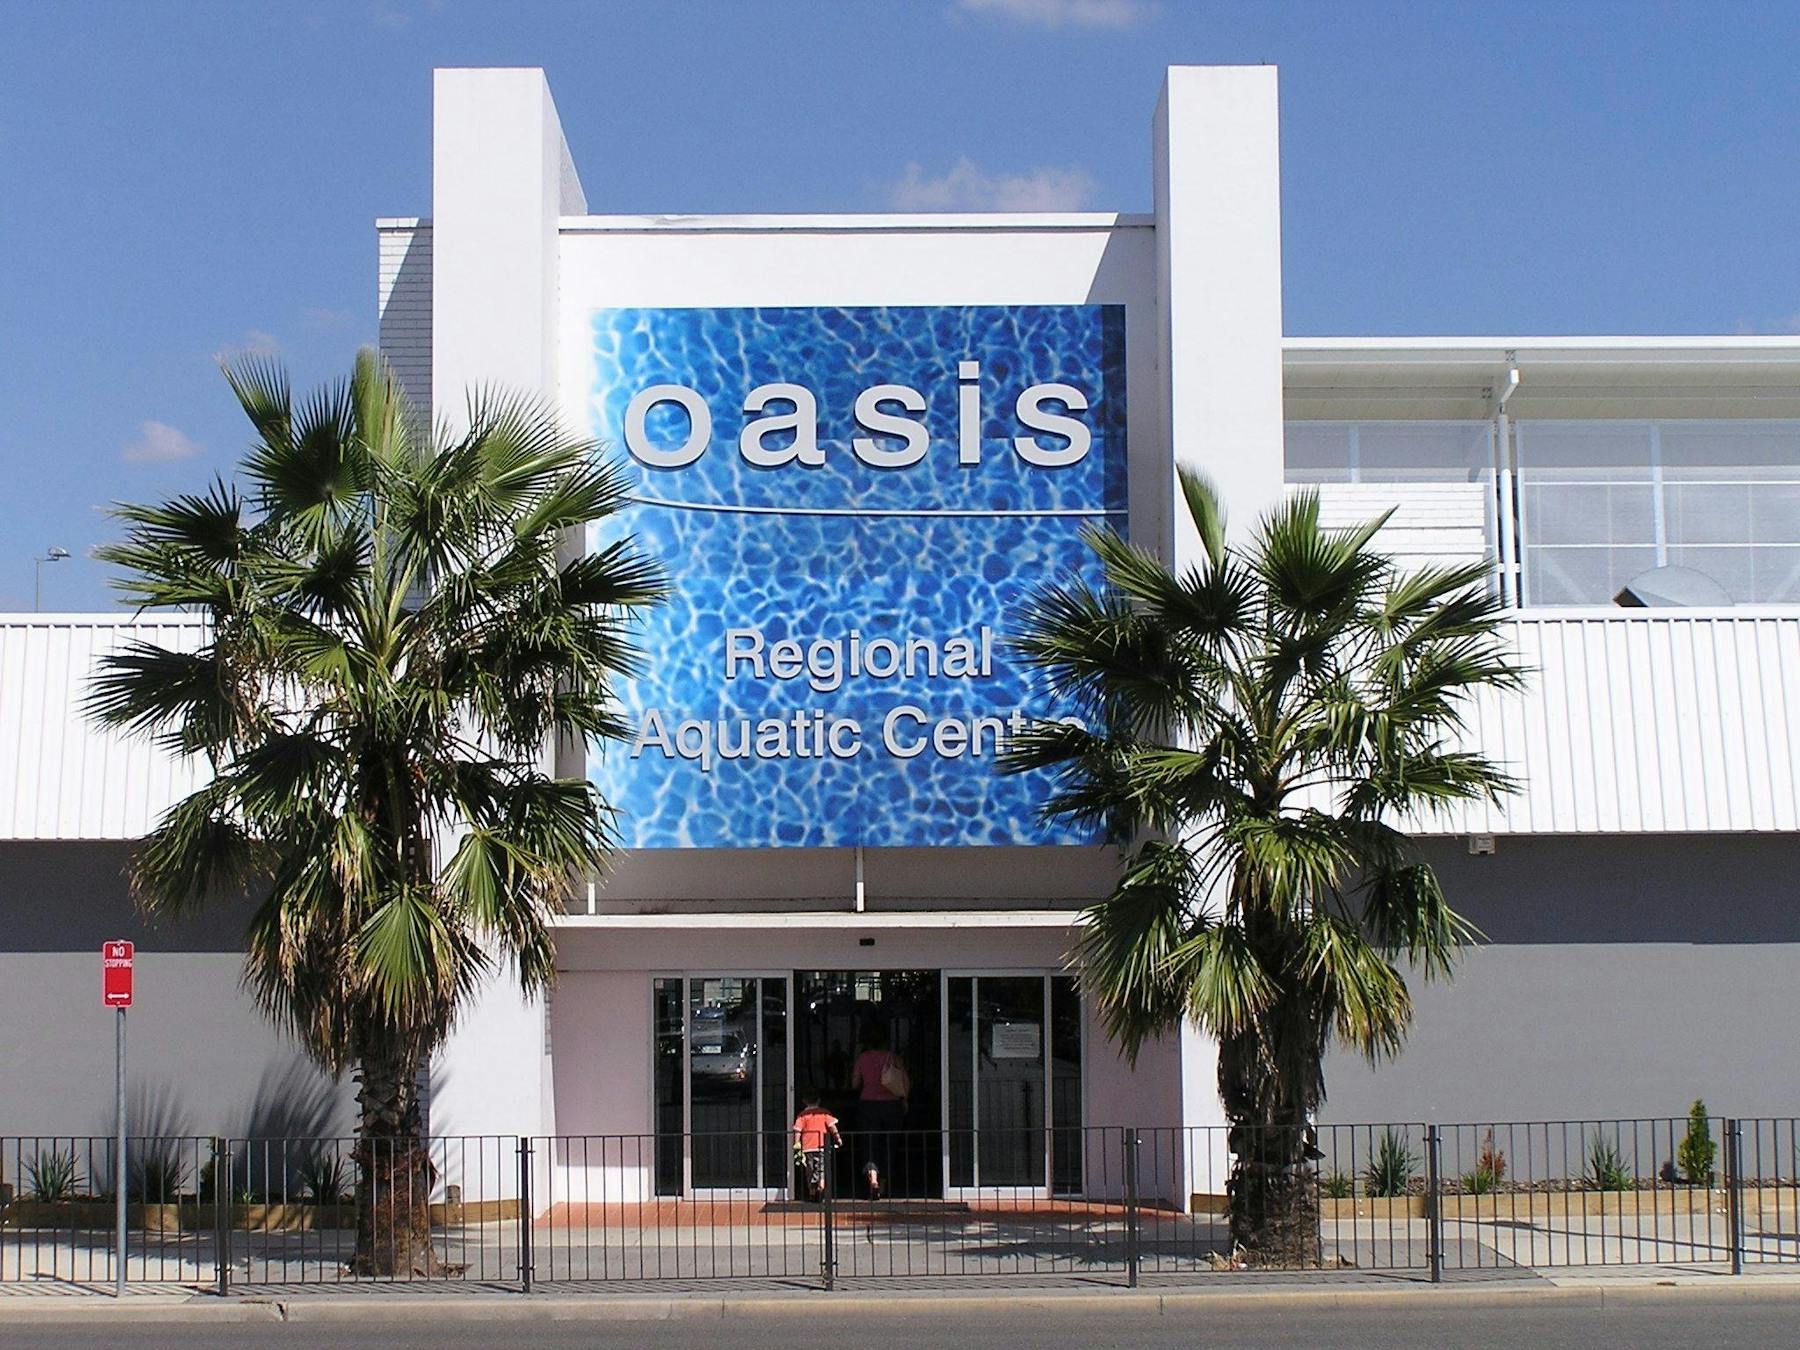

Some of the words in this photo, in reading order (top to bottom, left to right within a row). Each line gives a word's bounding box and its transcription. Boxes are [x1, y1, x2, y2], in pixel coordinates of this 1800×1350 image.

[624, 361, 1092, 468] oasis
[725, 626, 993, 692] Regional
[630, 706, 862, 772] Aquatic
[882, 706, 1089, 759] Cent
[111, 945, 125, 957] NO
